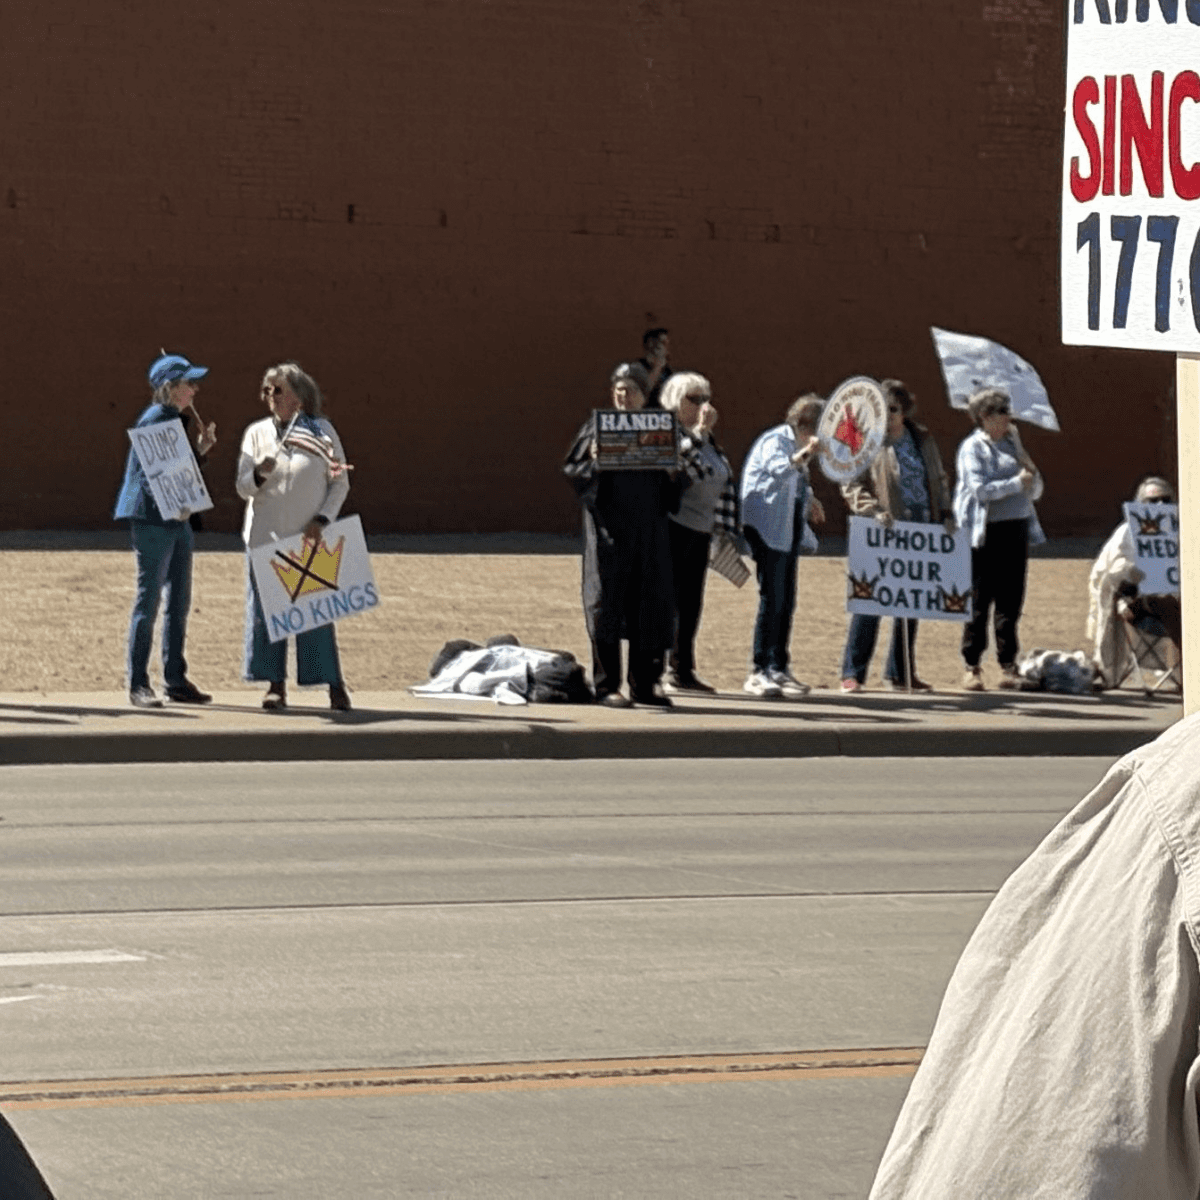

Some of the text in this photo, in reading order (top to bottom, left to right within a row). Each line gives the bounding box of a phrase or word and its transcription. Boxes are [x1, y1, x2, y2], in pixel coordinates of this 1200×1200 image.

[600, 413, 673, 432] HANDS
[137, 426, 181, 467] DUMP
[866, 527, 956, 554] UPHOLD
[877, 556, 943, 582] YOUR
[271, 581, 379, 638] NO KINGS
[877, 585, 941, 611] OATH
